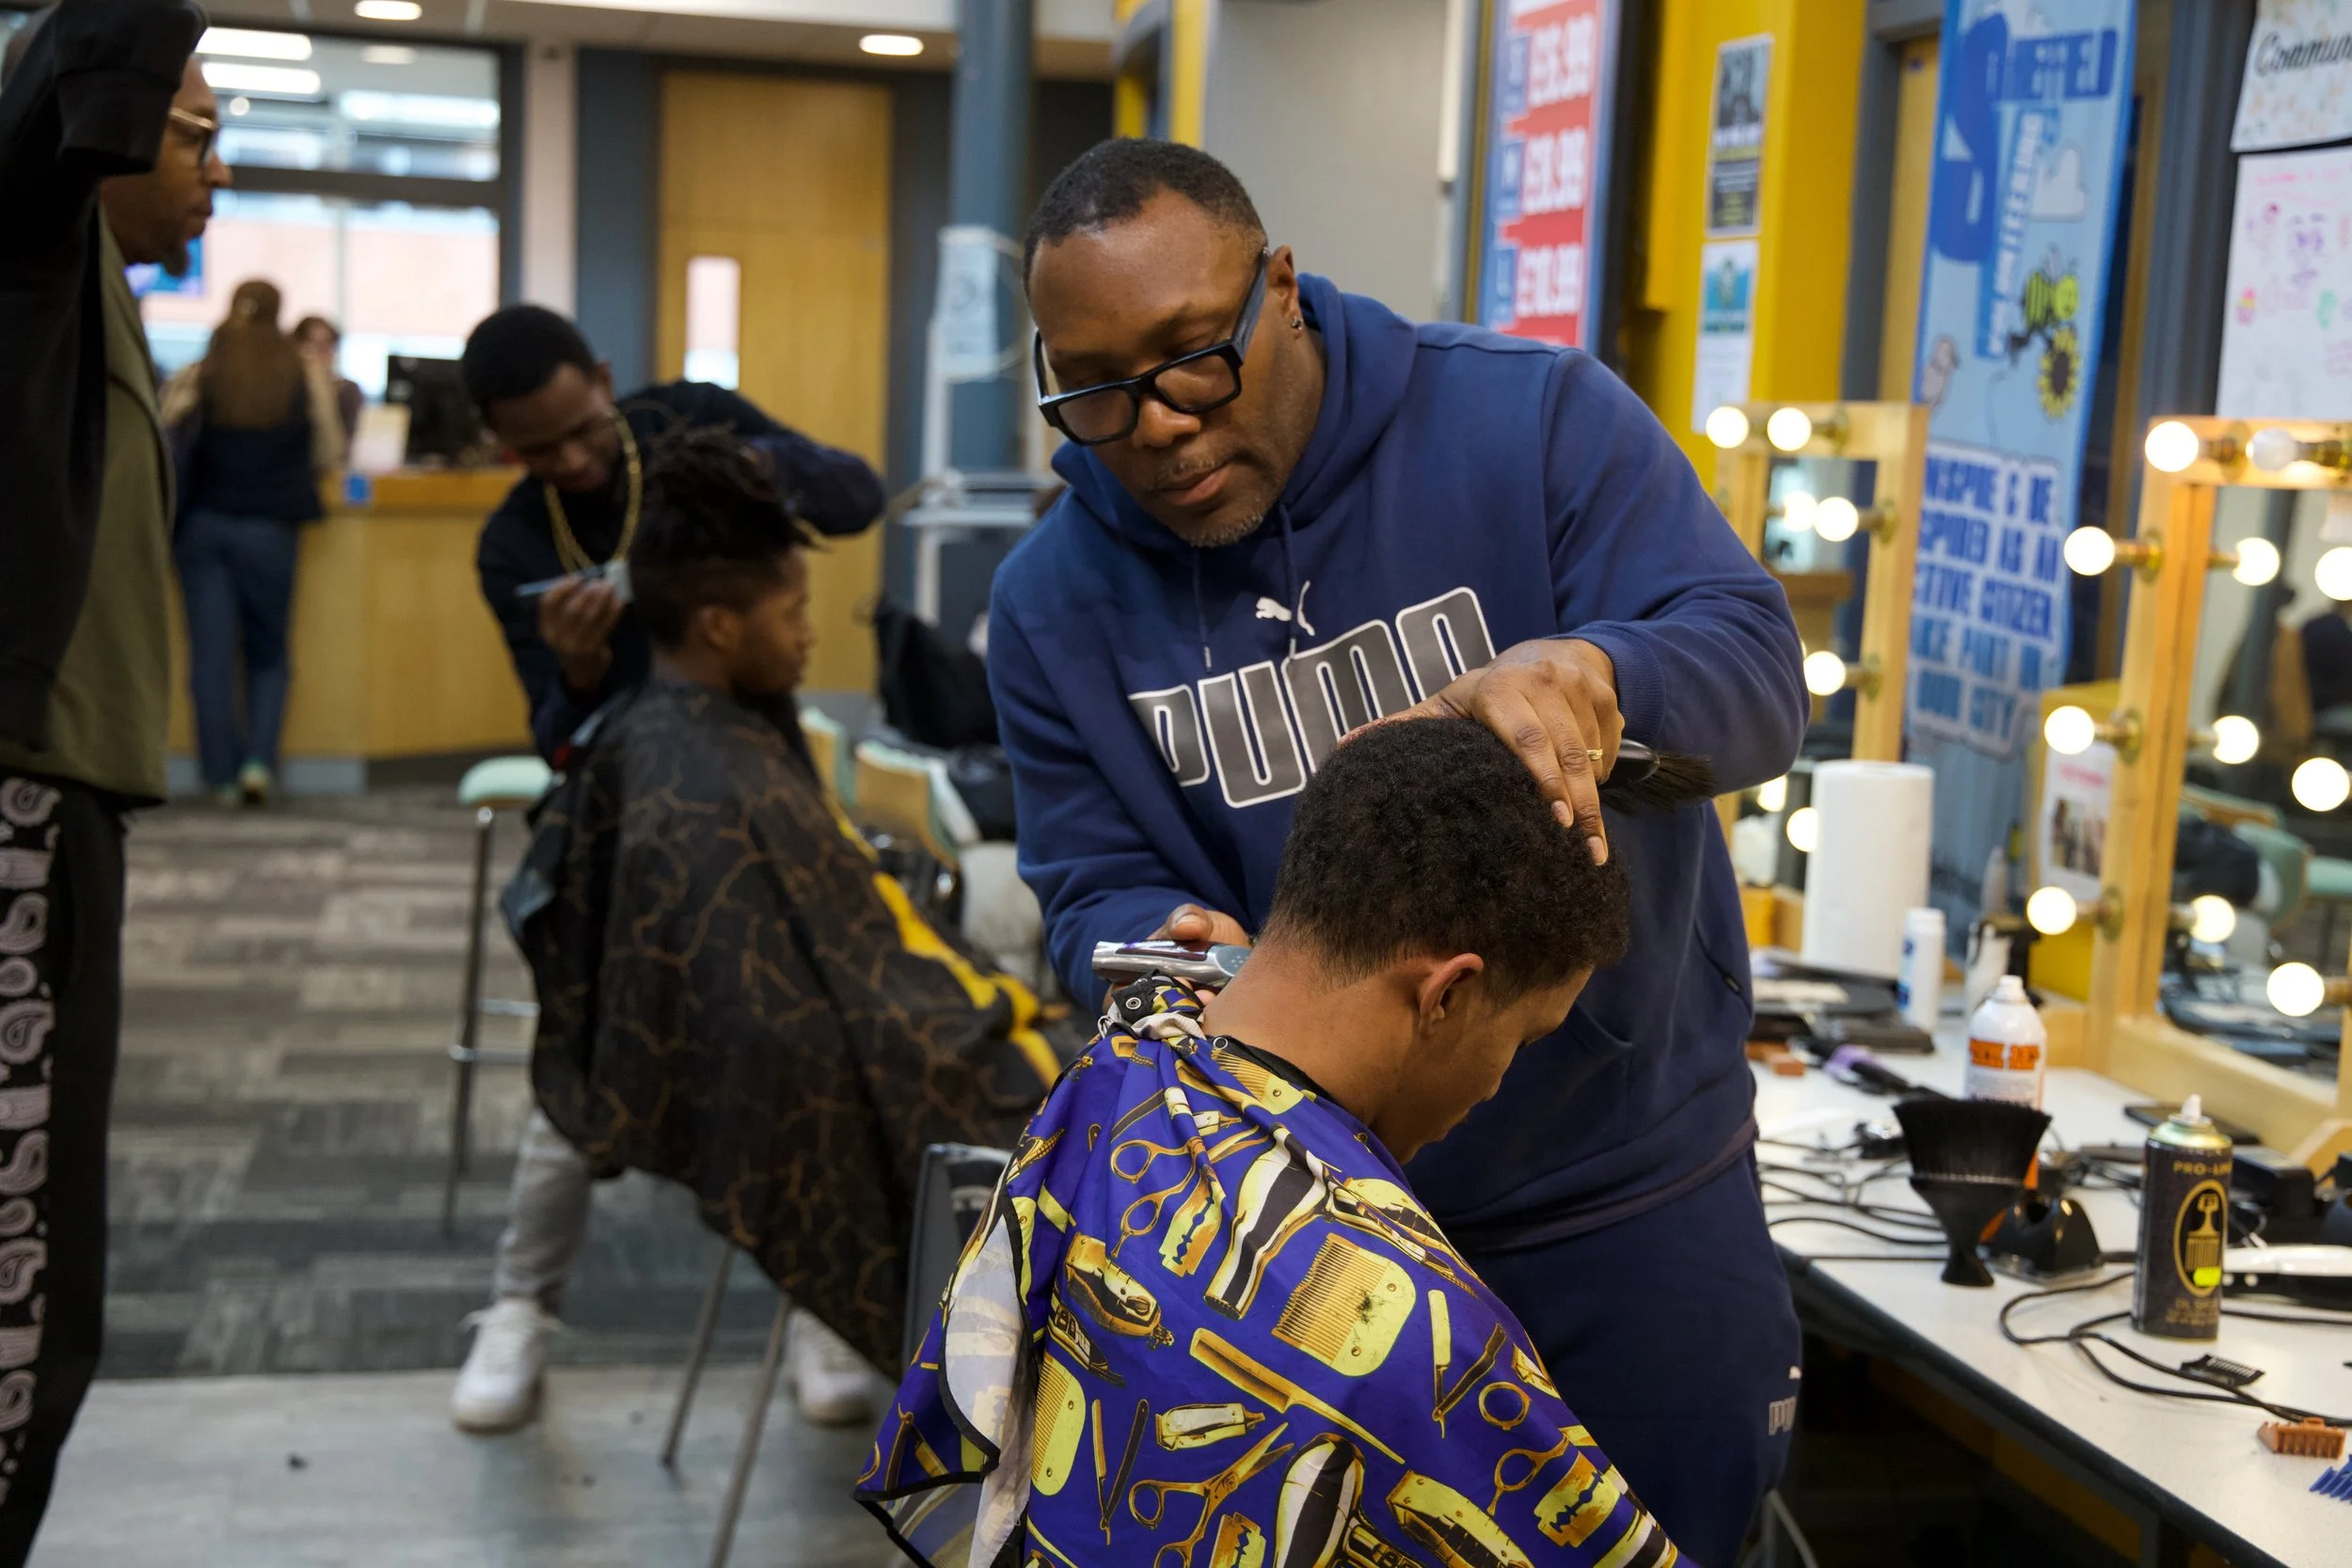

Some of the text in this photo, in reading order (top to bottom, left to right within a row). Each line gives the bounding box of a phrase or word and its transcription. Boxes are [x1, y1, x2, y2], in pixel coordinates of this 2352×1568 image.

[2255, 31, 2352, 77] Commun
[1128, 586, 1498, 809] PUMA
[1769, 1396, 1797, 1436] PU
